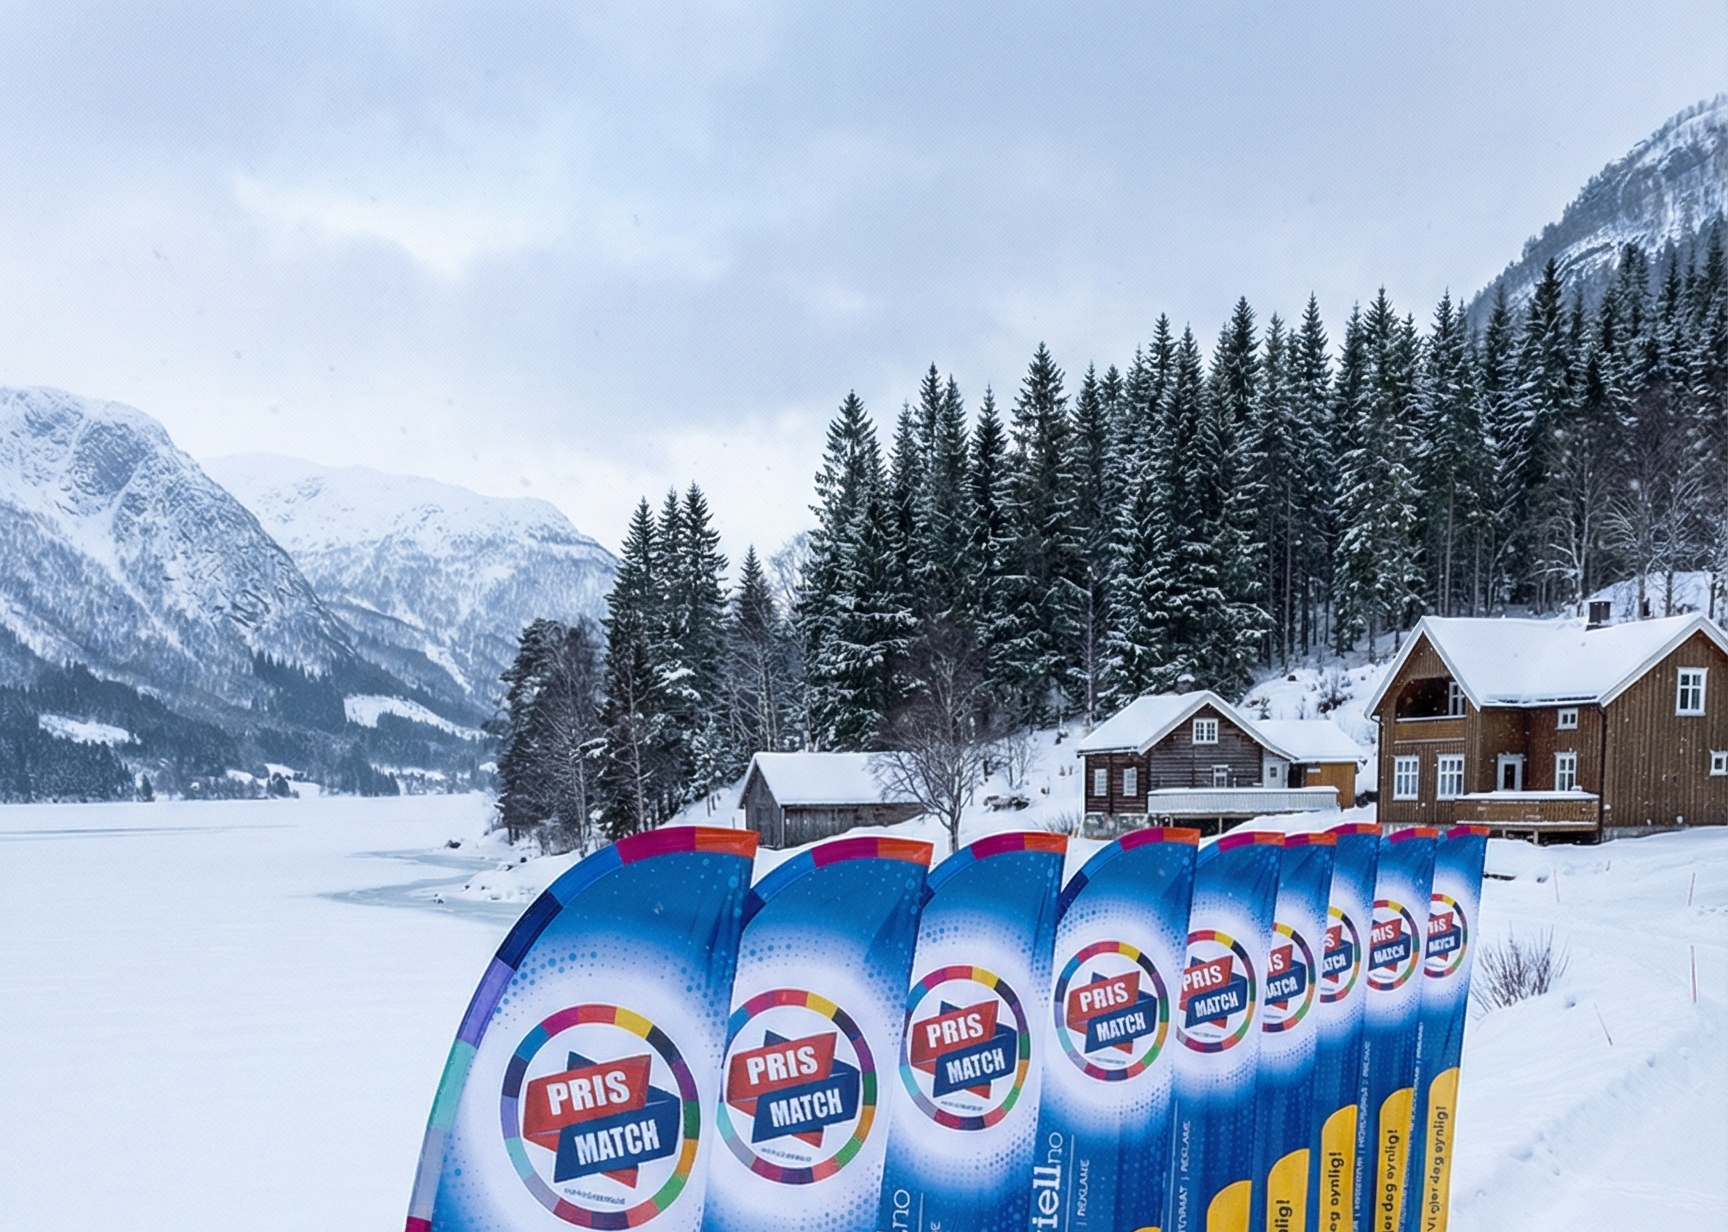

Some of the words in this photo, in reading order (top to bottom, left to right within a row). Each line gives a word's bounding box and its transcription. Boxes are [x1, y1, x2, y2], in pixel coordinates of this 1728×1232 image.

[1079, 981, 1129, 1013] PRIS
[1195, 991, 1239, 1018] MATCH
[926, 1013, 984, 1048] PRIS
[1095, 1012, 1146, 1042] MATCH
[746, 1046, 819, 1085] PRIS
[946, 1048, 1006, 1084] MATCH
[546, 1071, 631, 1116] PRIS
[769, 1088, 843, 1127] MATCH
[574, 1119, 660, 1166] MATCH
